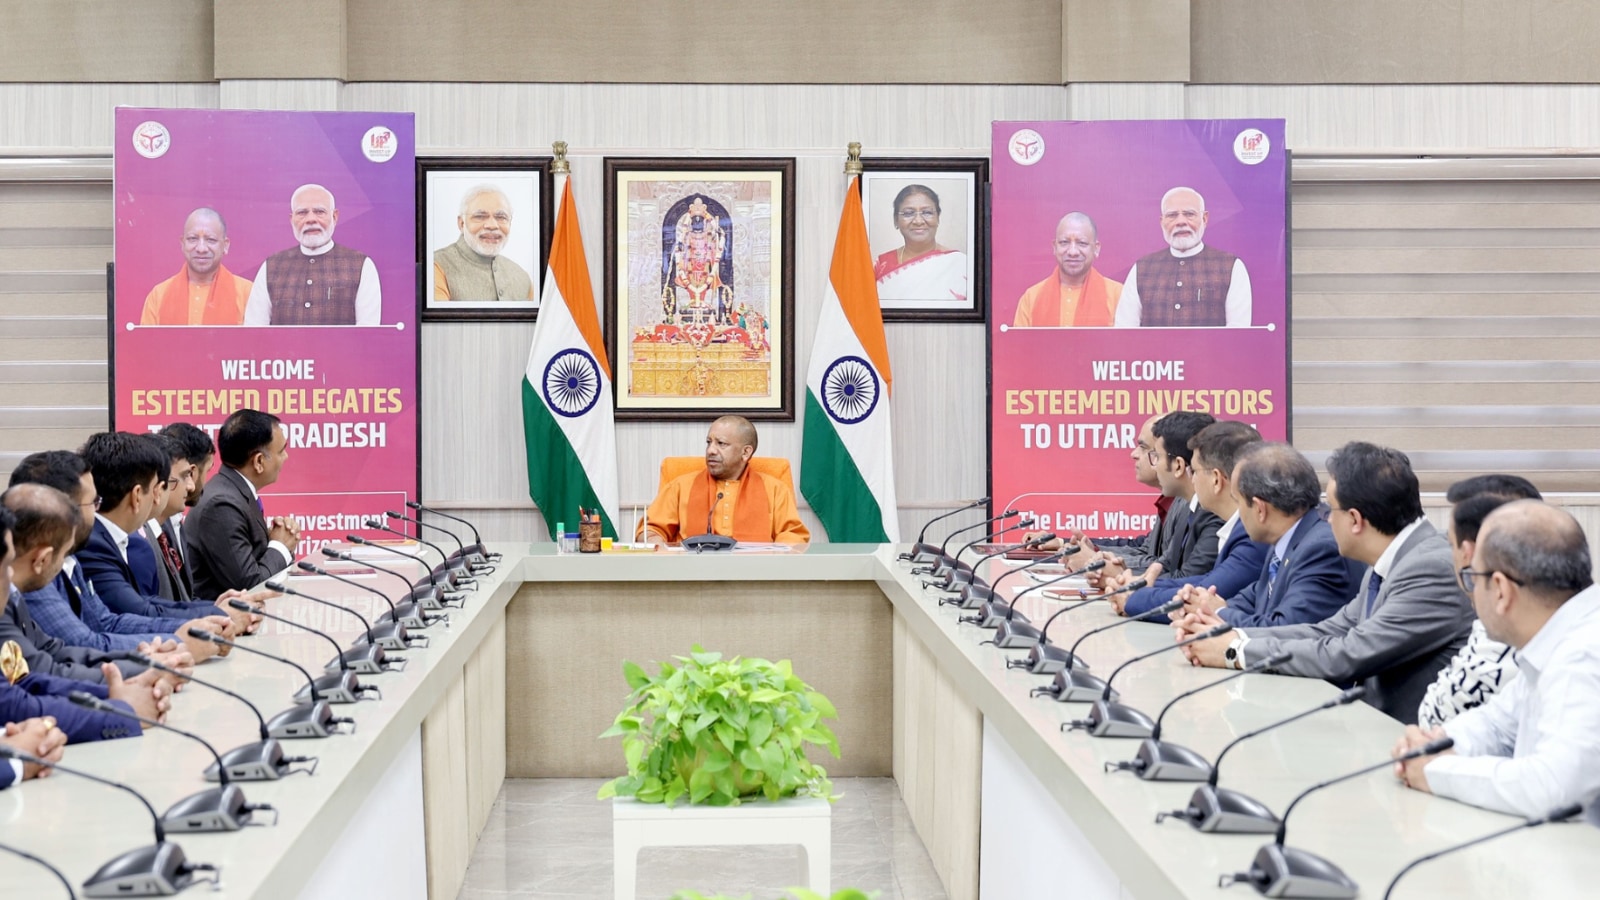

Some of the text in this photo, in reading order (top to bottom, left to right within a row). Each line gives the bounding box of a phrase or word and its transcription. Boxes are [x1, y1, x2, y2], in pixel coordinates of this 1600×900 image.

[221, 359, 315, 381] WELCOME
[1092, 360, 1185, 381] WELCOME
[132, 387, 403, 416] ESTEEMED DELEGATES
[1005, 389, 1274, 416] ESTEEMED INVESTORS
[1020, 423, 1136, 449] TO UTTAR
[1018, 511, 1157, 531] The Land Where
